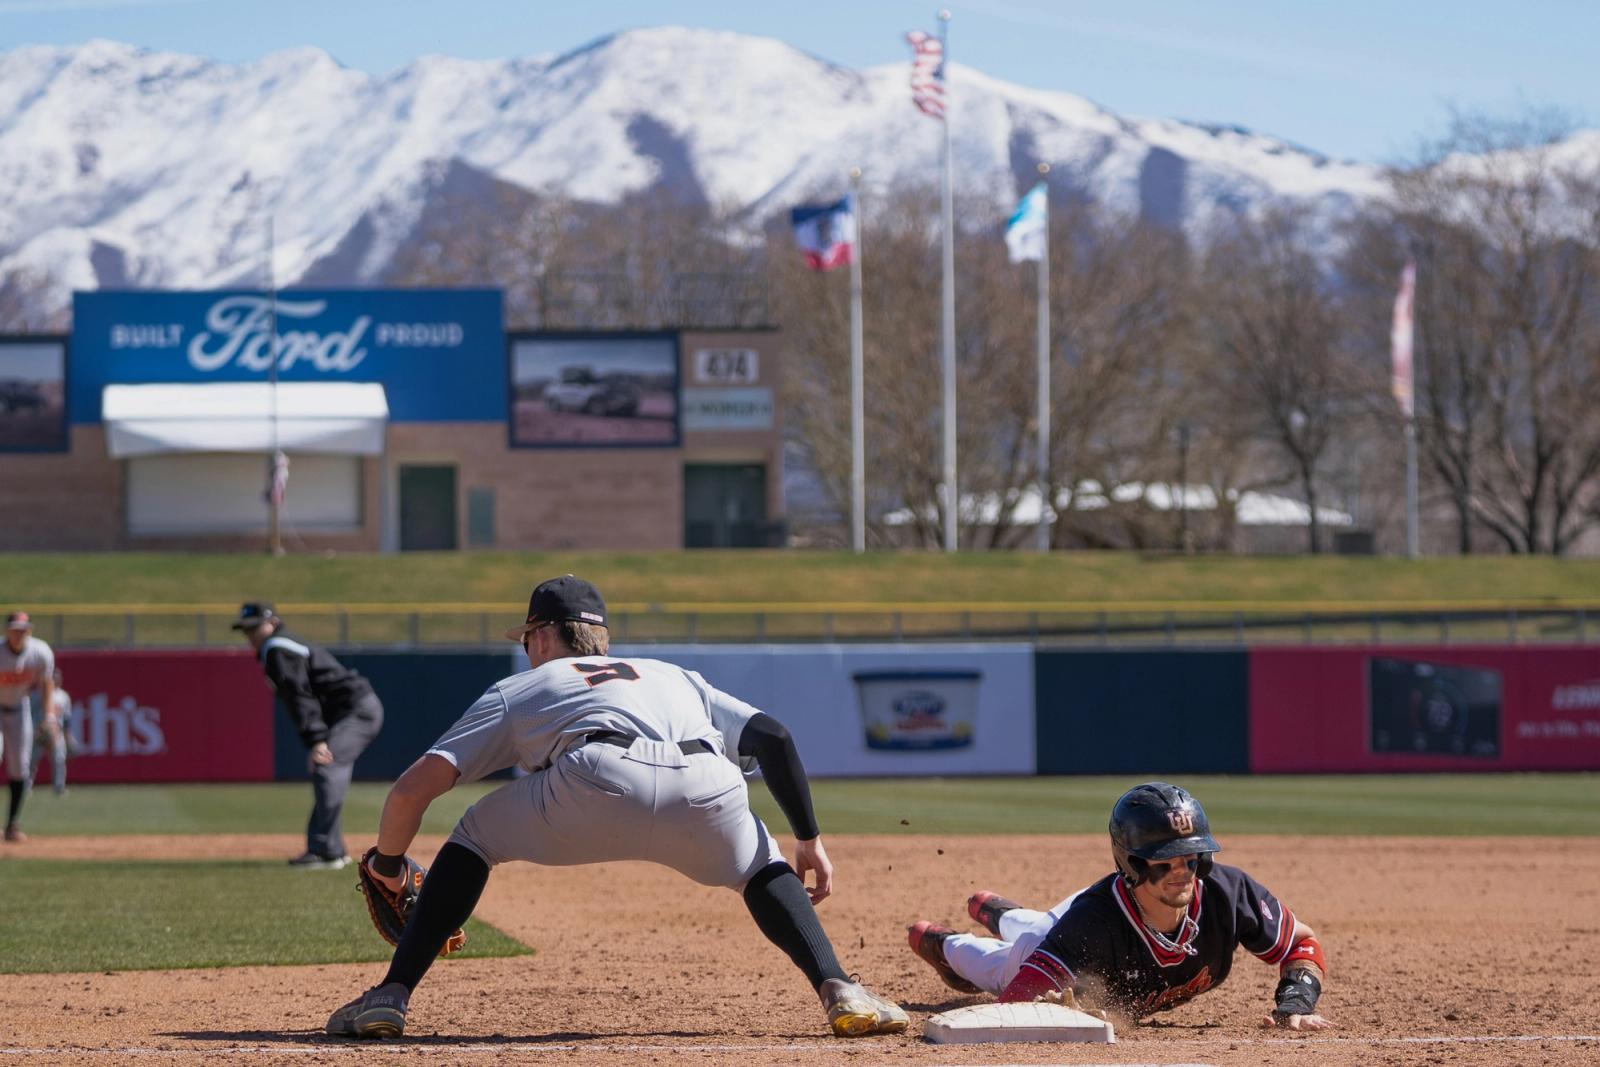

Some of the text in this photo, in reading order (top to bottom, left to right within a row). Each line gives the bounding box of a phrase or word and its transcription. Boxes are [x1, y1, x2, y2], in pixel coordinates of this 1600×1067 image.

[110, 296, 463, 371] BUILT Ford PROUD
